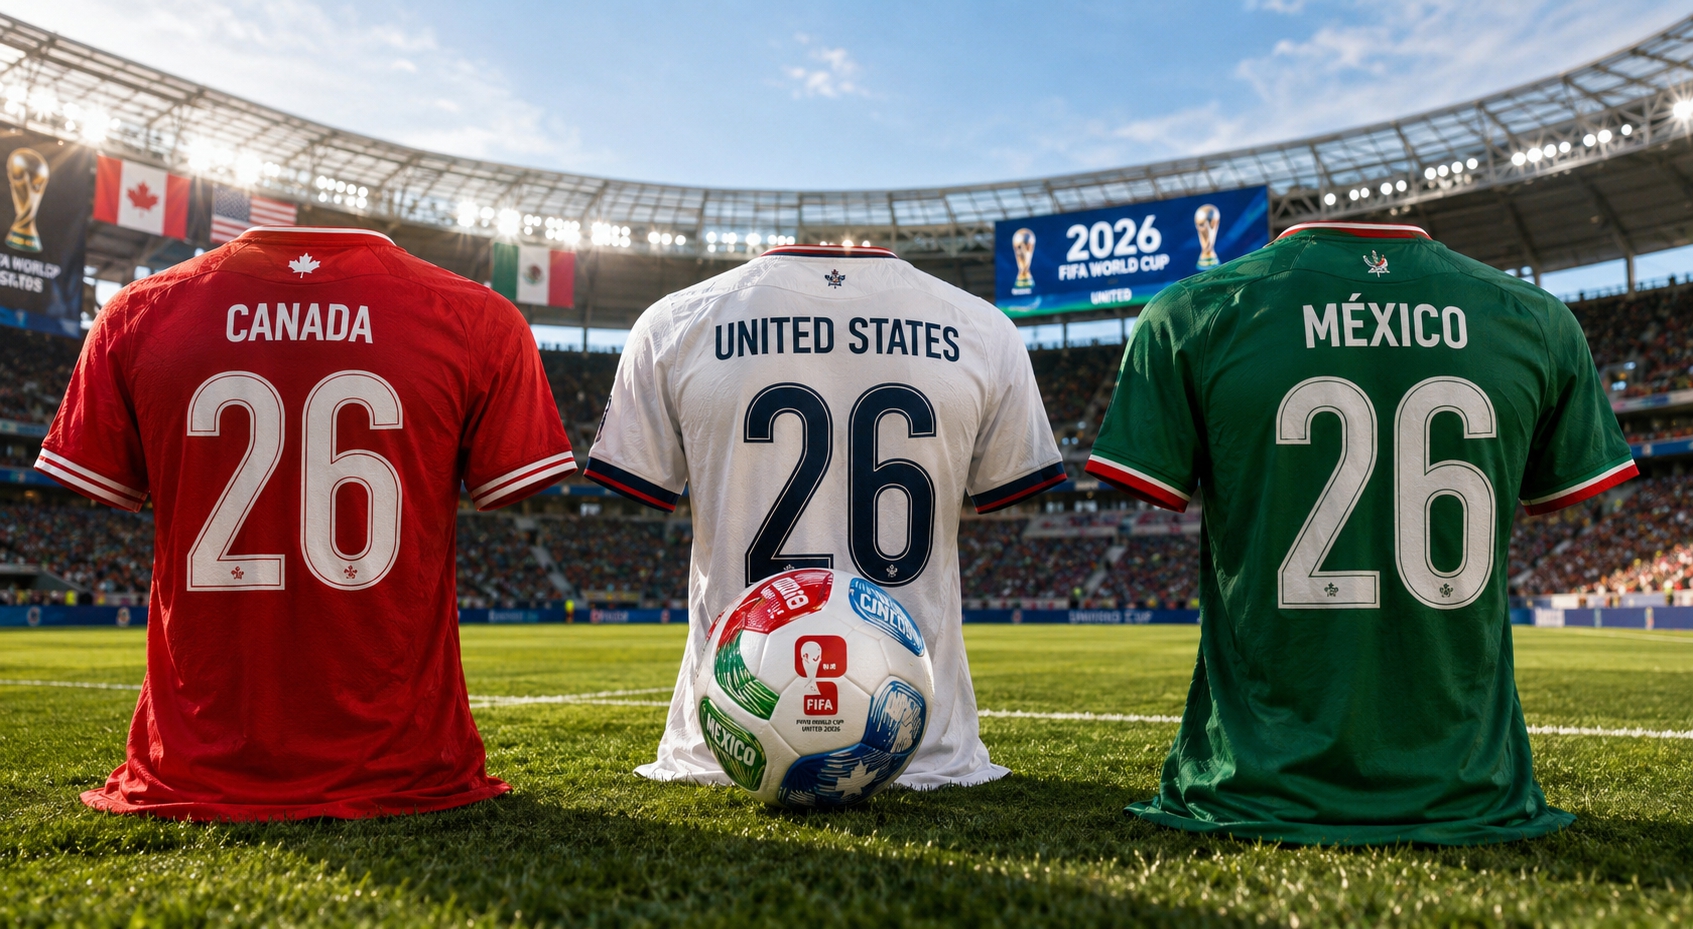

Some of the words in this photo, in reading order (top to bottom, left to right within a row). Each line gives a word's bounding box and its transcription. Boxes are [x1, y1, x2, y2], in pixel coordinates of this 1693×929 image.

[1066, 215, 1162, 262] 2026
[1058, 262, 1089, 281] FIFA
[1089, 256, 1139, 278] WORLD
[1140, 253, 1170, 272] CUP
[1090, 288, 1132, 305] UNITED
[226, 303, 373, 344] CANADA
[715, 316, 835, 360] UNITED
[849, 316, 960, 362] STATES
[1303, 293, 1468, 349] MÉXICO
[187, 370, 403, 592] 26
[744, 382, 936, 588] 26
[1276, 376, 1497, 610] 26
[806, 698, 834, 711] FIFA
[706, 712, 757, 767] MEXICO
